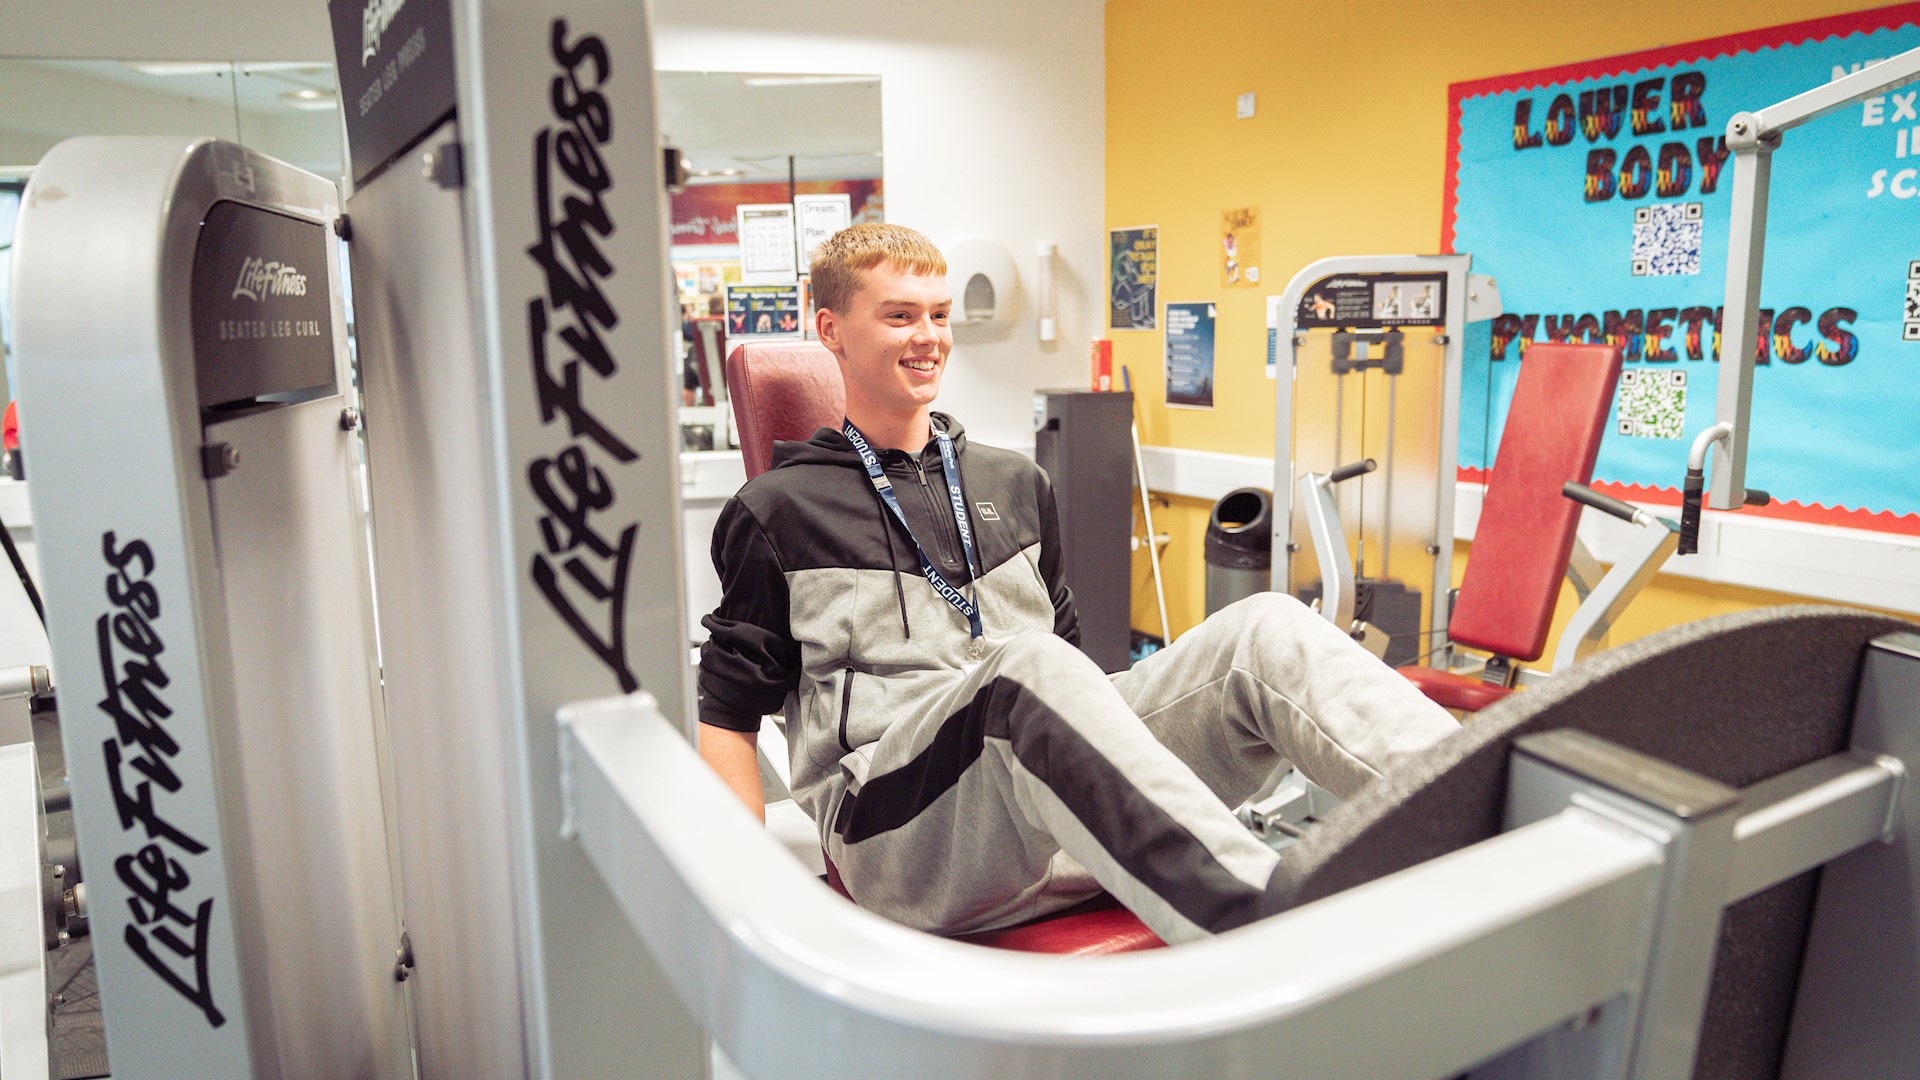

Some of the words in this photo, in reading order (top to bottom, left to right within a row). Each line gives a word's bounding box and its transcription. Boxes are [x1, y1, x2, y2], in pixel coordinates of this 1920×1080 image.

[1513, 71, 1707, 151] LOWER
[1584, 135, 1734, 203] BODY
[232, 256, 307, 302] LifeFitness
[220, 320, 266, 339] SEATED
[271, 320, 291, 337] LEG
[295, 320, 320, 336] CURL
[526, 18, 640, 694] LifeFitness
[844, 425, 877, 466] STUDENT
[950, 485, 972, 547] STUDENT
[922, 565, 974, 616] STUDENT
[97, 531, 226, 1028] LifeFitness
